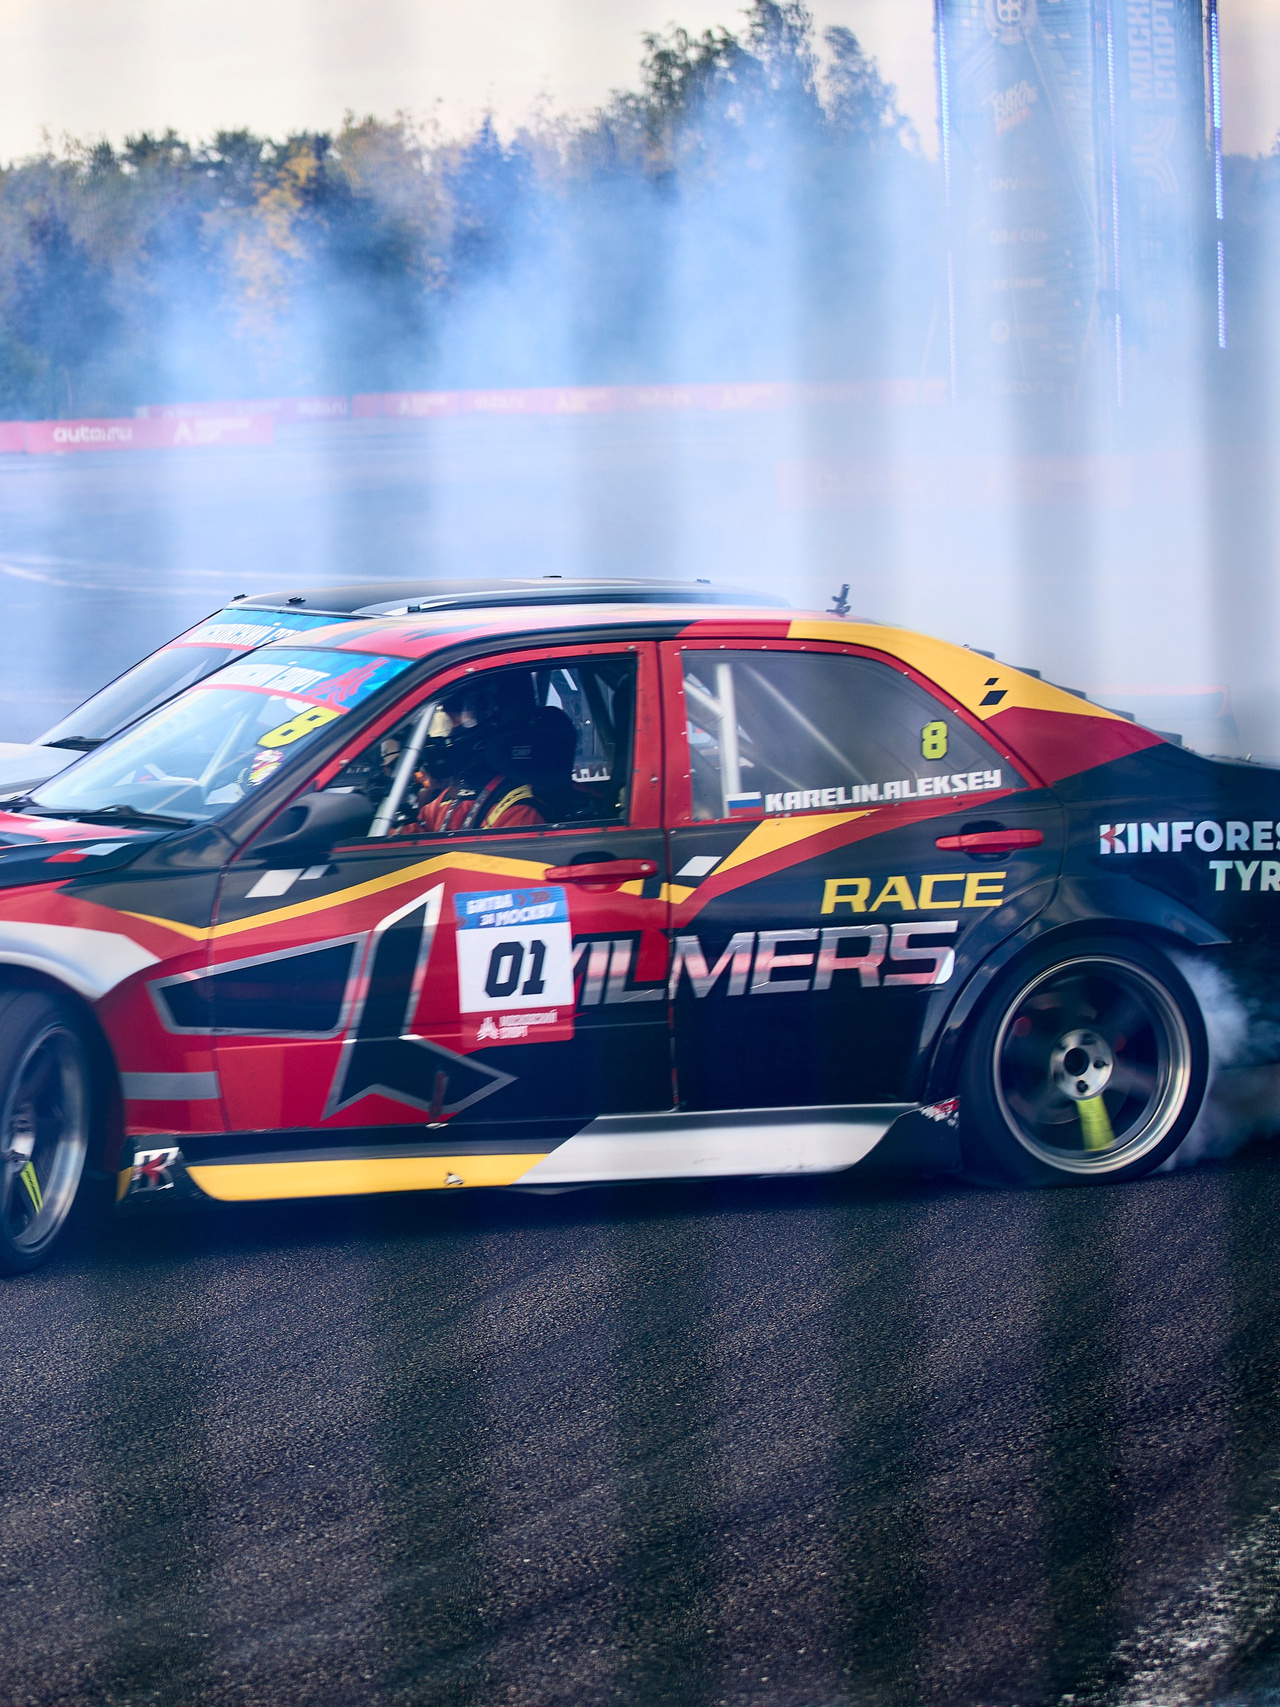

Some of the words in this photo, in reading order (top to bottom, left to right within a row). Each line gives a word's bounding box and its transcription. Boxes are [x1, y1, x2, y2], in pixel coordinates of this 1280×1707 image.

[1127, 0, 1152, 99] МОСК
[921, 720, 948, 760] 8
[764, 769, 1002, 812] KARELIN.ALEKSEY
[1099, 820, 1280, 855] KINFORE
[820, 871, 1007, 914] RACE
[484, 939, 546, 998] 01
